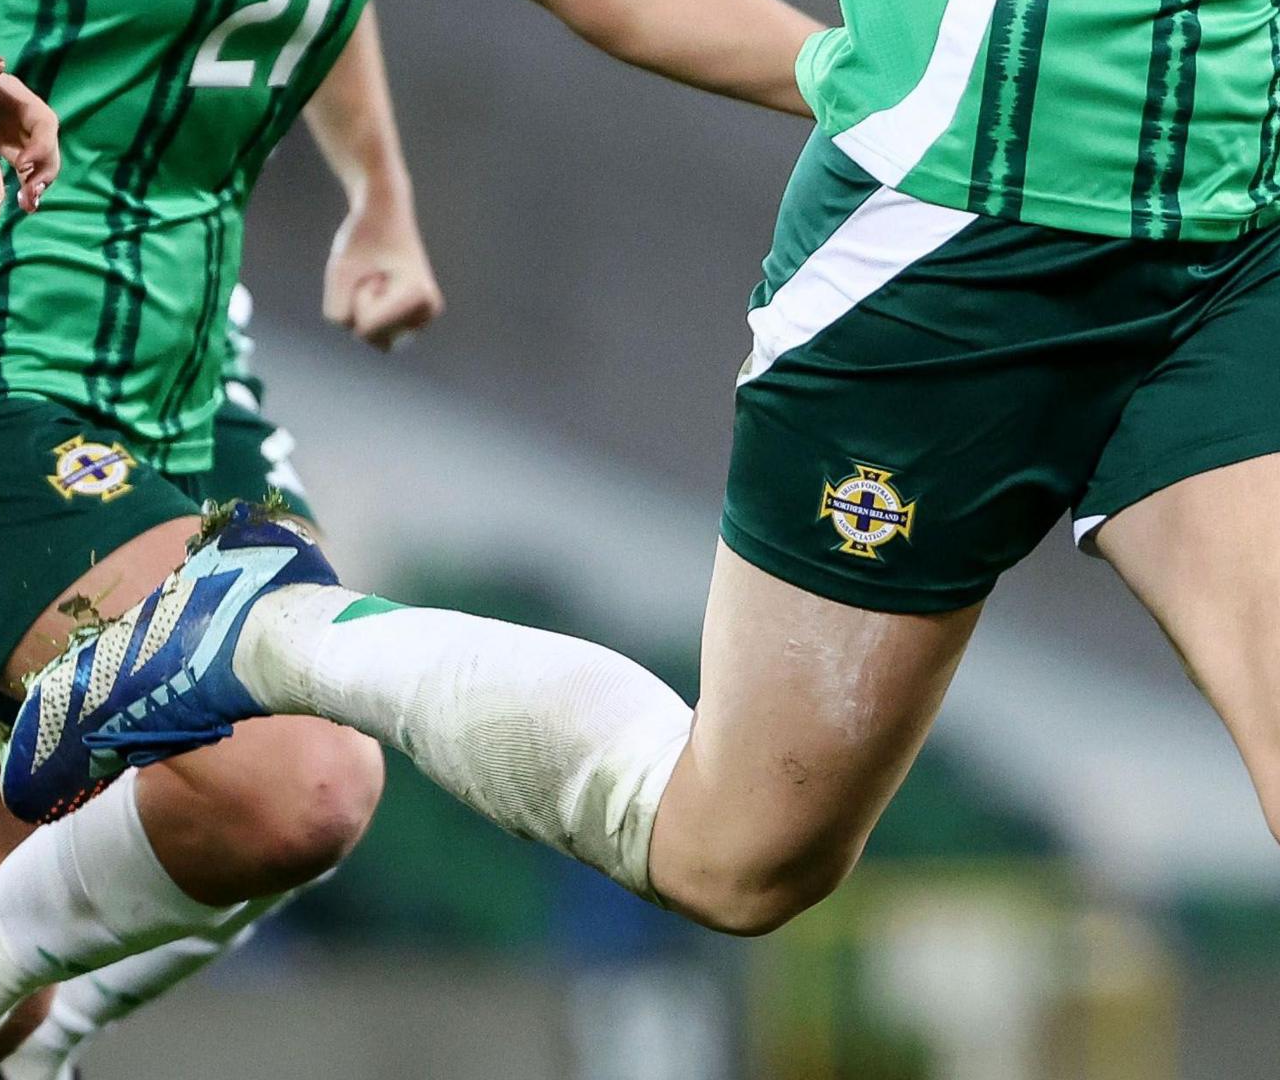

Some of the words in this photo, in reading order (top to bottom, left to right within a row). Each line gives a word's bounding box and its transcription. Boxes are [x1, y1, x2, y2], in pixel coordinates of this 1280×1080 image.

[840, 481, 859, 496] IRISH
[861, 480, 893, 505] FOOTBALL
[832, 499, 868, 516] NORTHERN
[869, 509, 899, 522] IRELAND
[838, 518, 888, 541] ASSOCIATION
